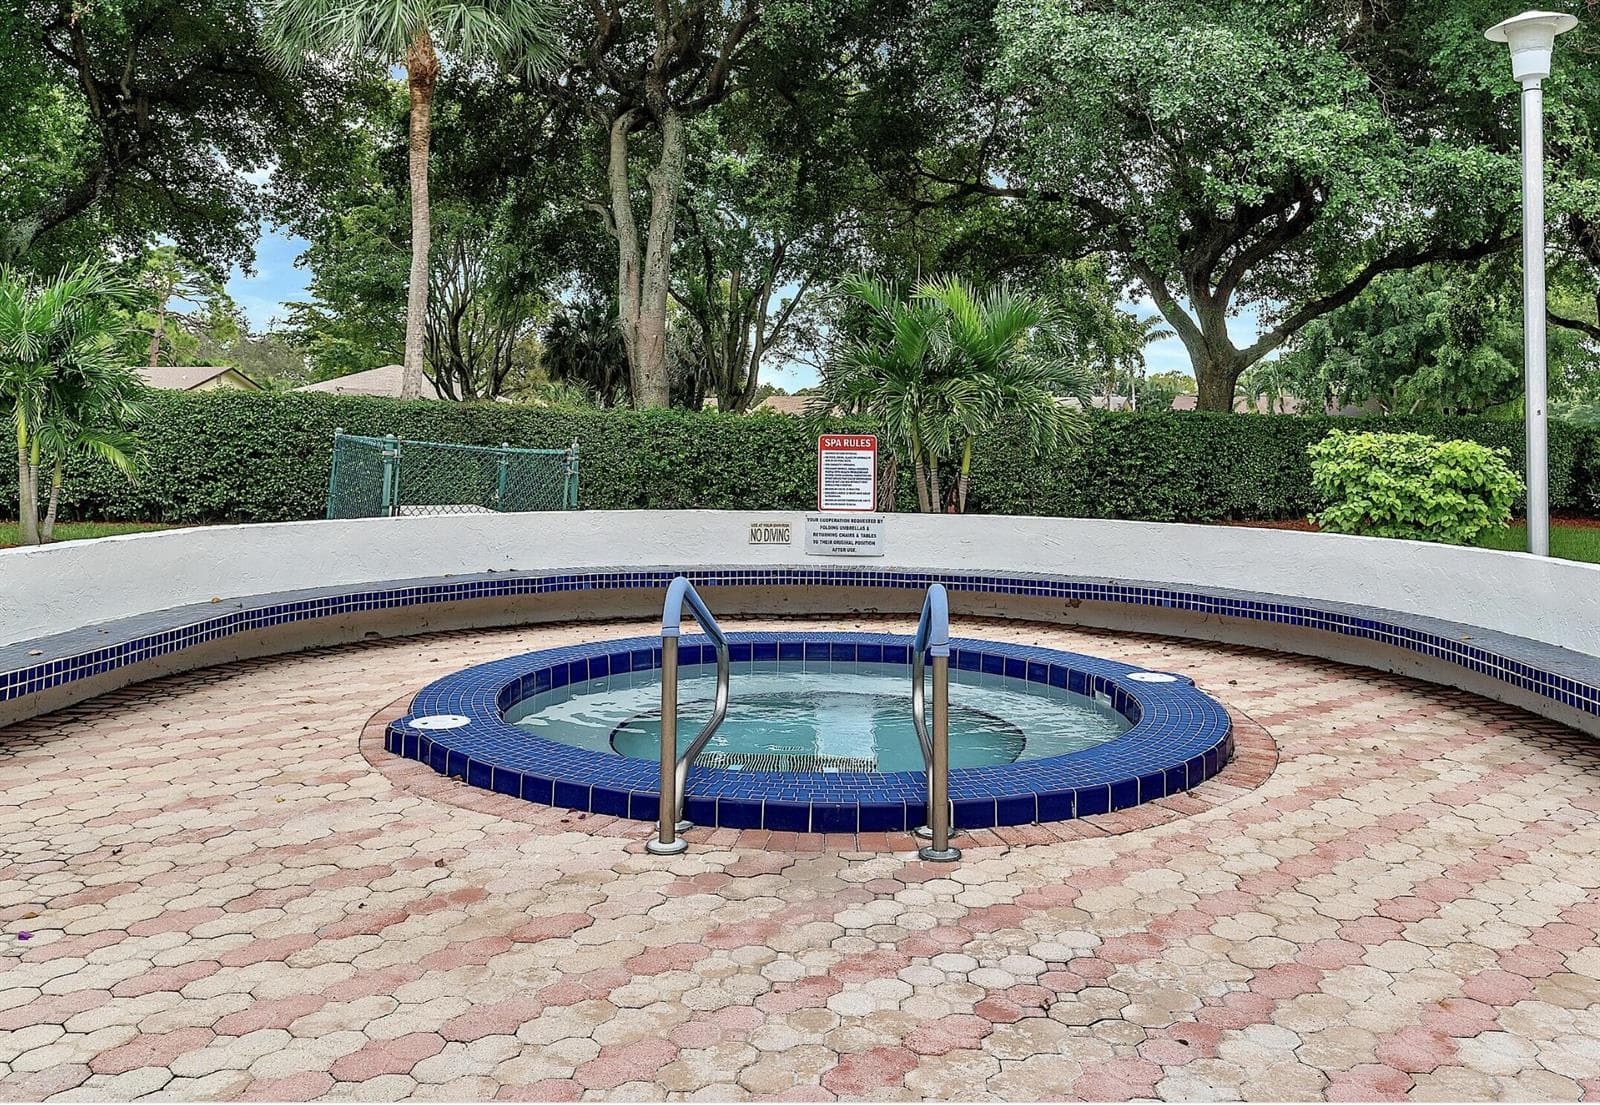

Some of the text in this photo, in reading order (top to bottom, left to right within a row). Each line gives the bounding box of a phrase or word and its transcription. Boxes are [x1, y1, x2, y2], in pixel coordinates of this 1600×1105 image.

[824, 438, 871, 448] SPA RULES
[750, 528, 790, 542] NO DIVING
